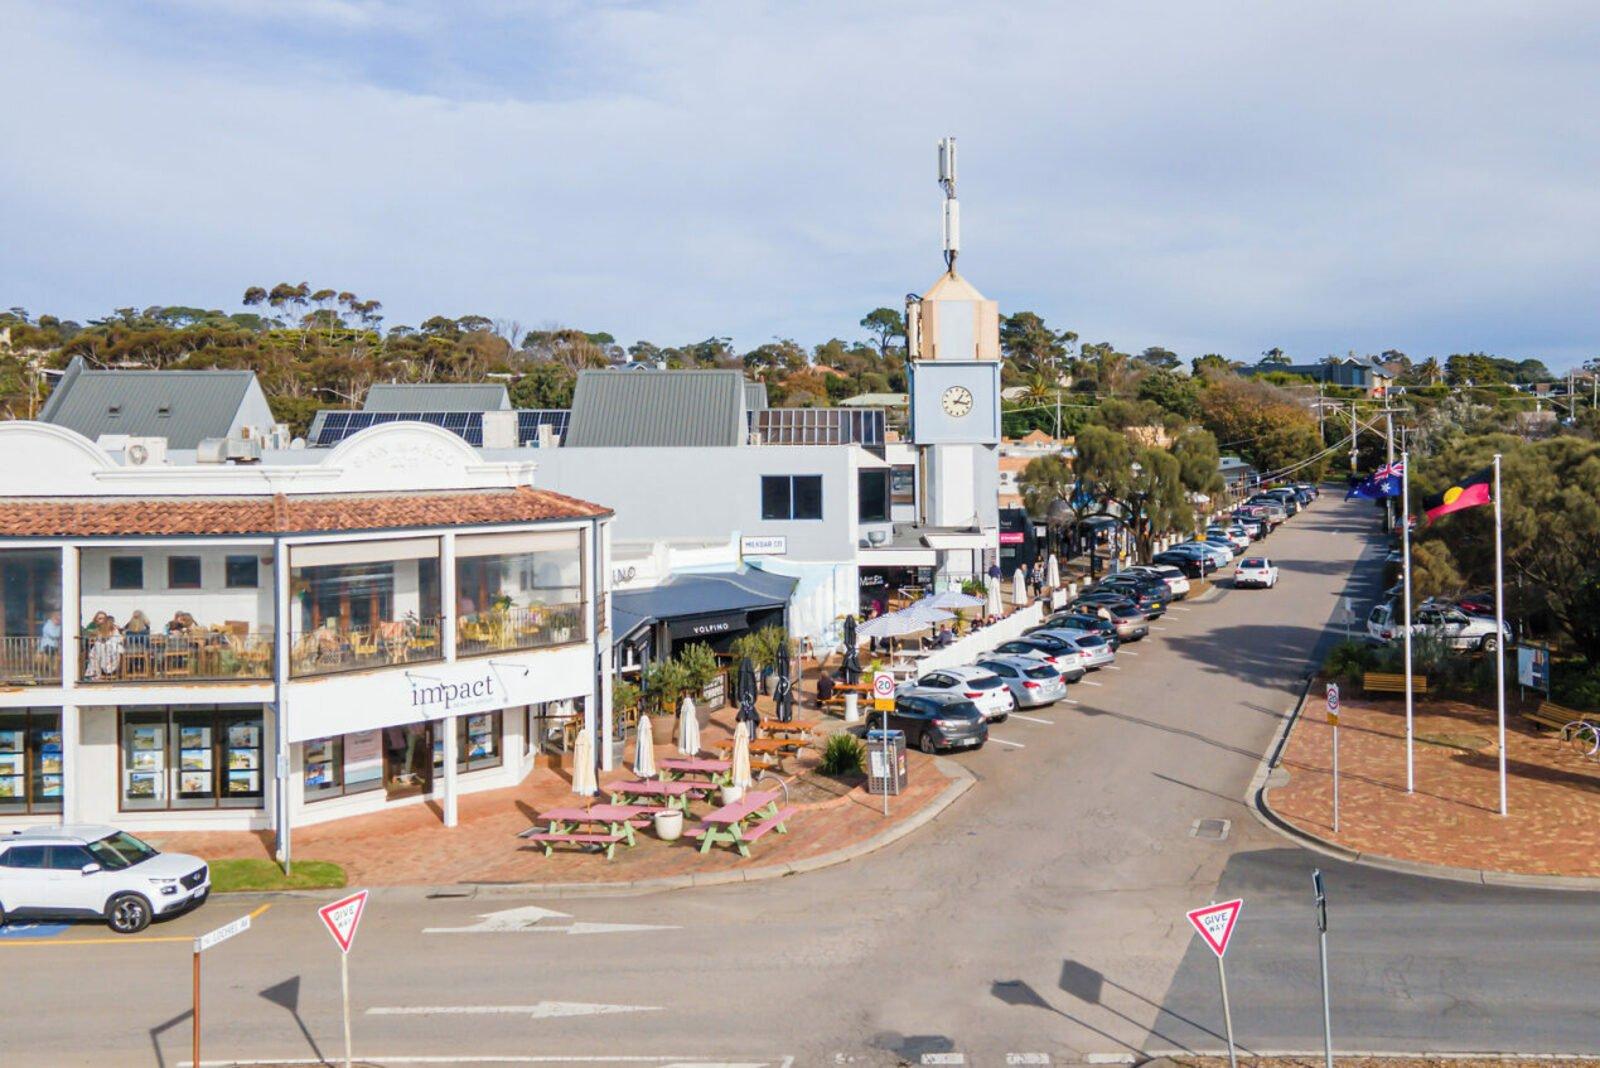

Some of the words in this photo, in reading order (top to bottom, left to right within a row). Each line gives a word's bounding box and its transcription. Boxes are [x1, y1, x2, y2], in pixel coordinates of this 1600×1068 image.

[411, 675, 494, 709] impact
[878, 680, 891, 690] 20
[334, 905, 354, 921] GIVE
[1204, 911, 1228, 926] GIVE
